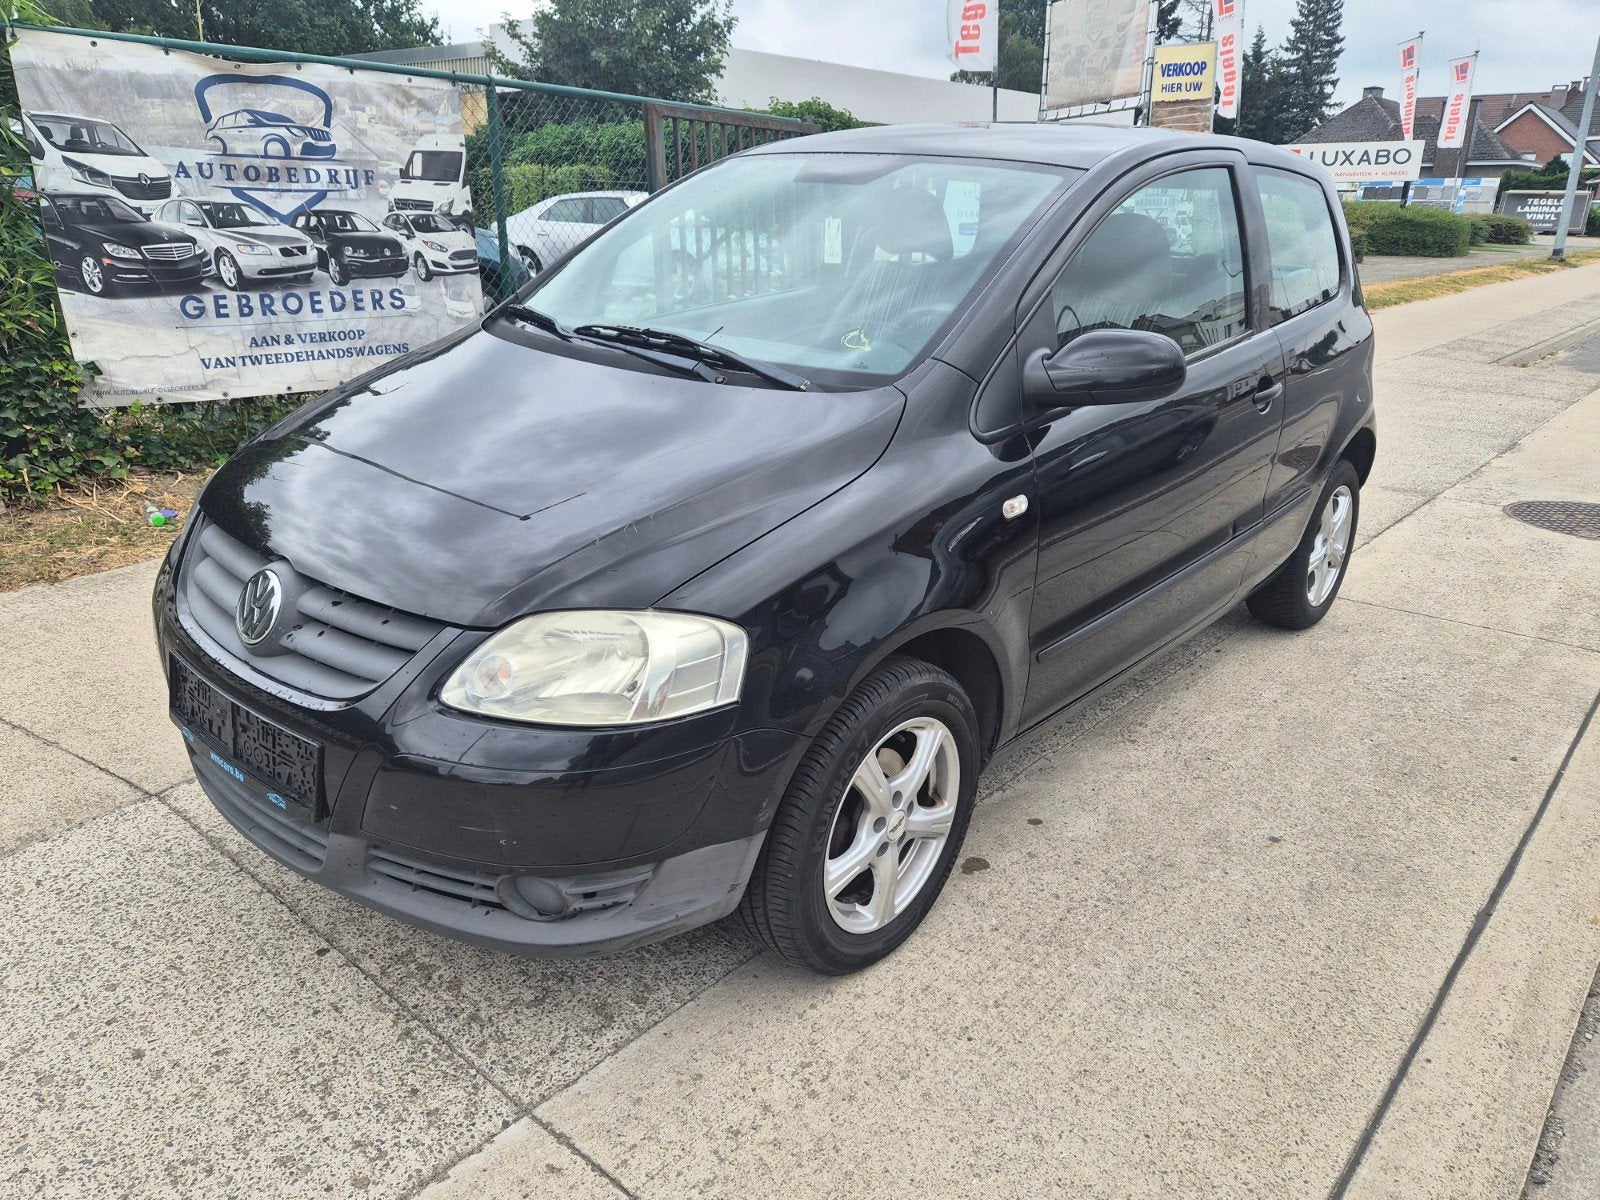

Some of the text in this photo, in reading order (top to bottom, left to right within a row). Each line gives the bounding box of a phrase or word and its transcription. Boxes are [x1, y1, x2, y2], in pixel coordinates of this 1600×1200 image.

[955, 0, 986, 61] Teg
[1161, 61, 1207, 77] VERKOOP
[1220, 33, 1236, 109] Tegels
[1161, 82, 1203, 93] HIER UW
[1444, 93, 1464, 142] Tegels
[174, 160, 375, 189] AUTOBEDRIJF
[179, 288, 406, 320] GEBROEDERS
[249, 329, 366, 348] AAN & VERKOOP
[200, 343, 409, 370] VAN TWEEDEHANDSWAGENS
